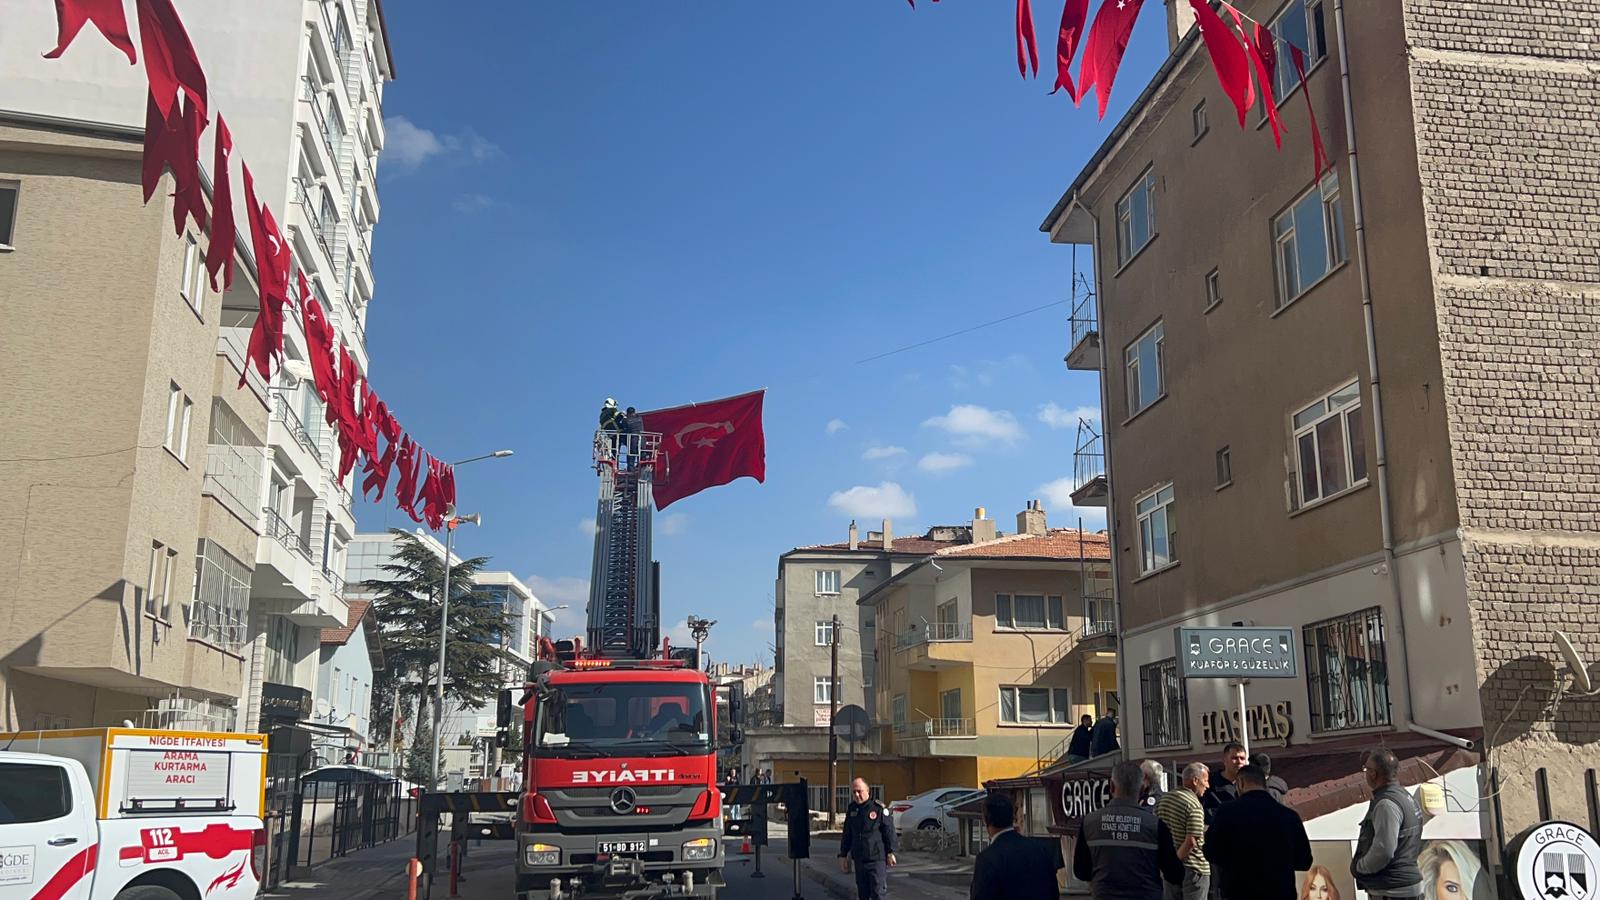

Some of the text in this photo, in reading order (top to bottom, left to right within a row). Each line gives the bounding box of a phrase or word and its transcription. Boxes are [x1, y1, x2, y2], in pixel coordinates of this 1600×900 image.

[1208, 637, 1273, 654] GRACE
[1190, 657, 1289, 670] KUAFÖR & GÜZELLİK
[1201, 702, 1291, 748] HASTAŞ
[149, 735, 226, 748] NİĞDE İTFAİYESİ
[163, 751, 199, 761] ARAMA
[154, 762, 207, 772] KURTARMA
[165, 775, 196, 784] ARACI
[1062, 779, 1110, 817] GRACE
[150, 828, 175, 846] 112
[1111, 832, 1129, 841] 188
[1534, 826, 1586, 847] GRACE
[603, 843, 613, 852] 51
[630, 842, 644, 851] 912
